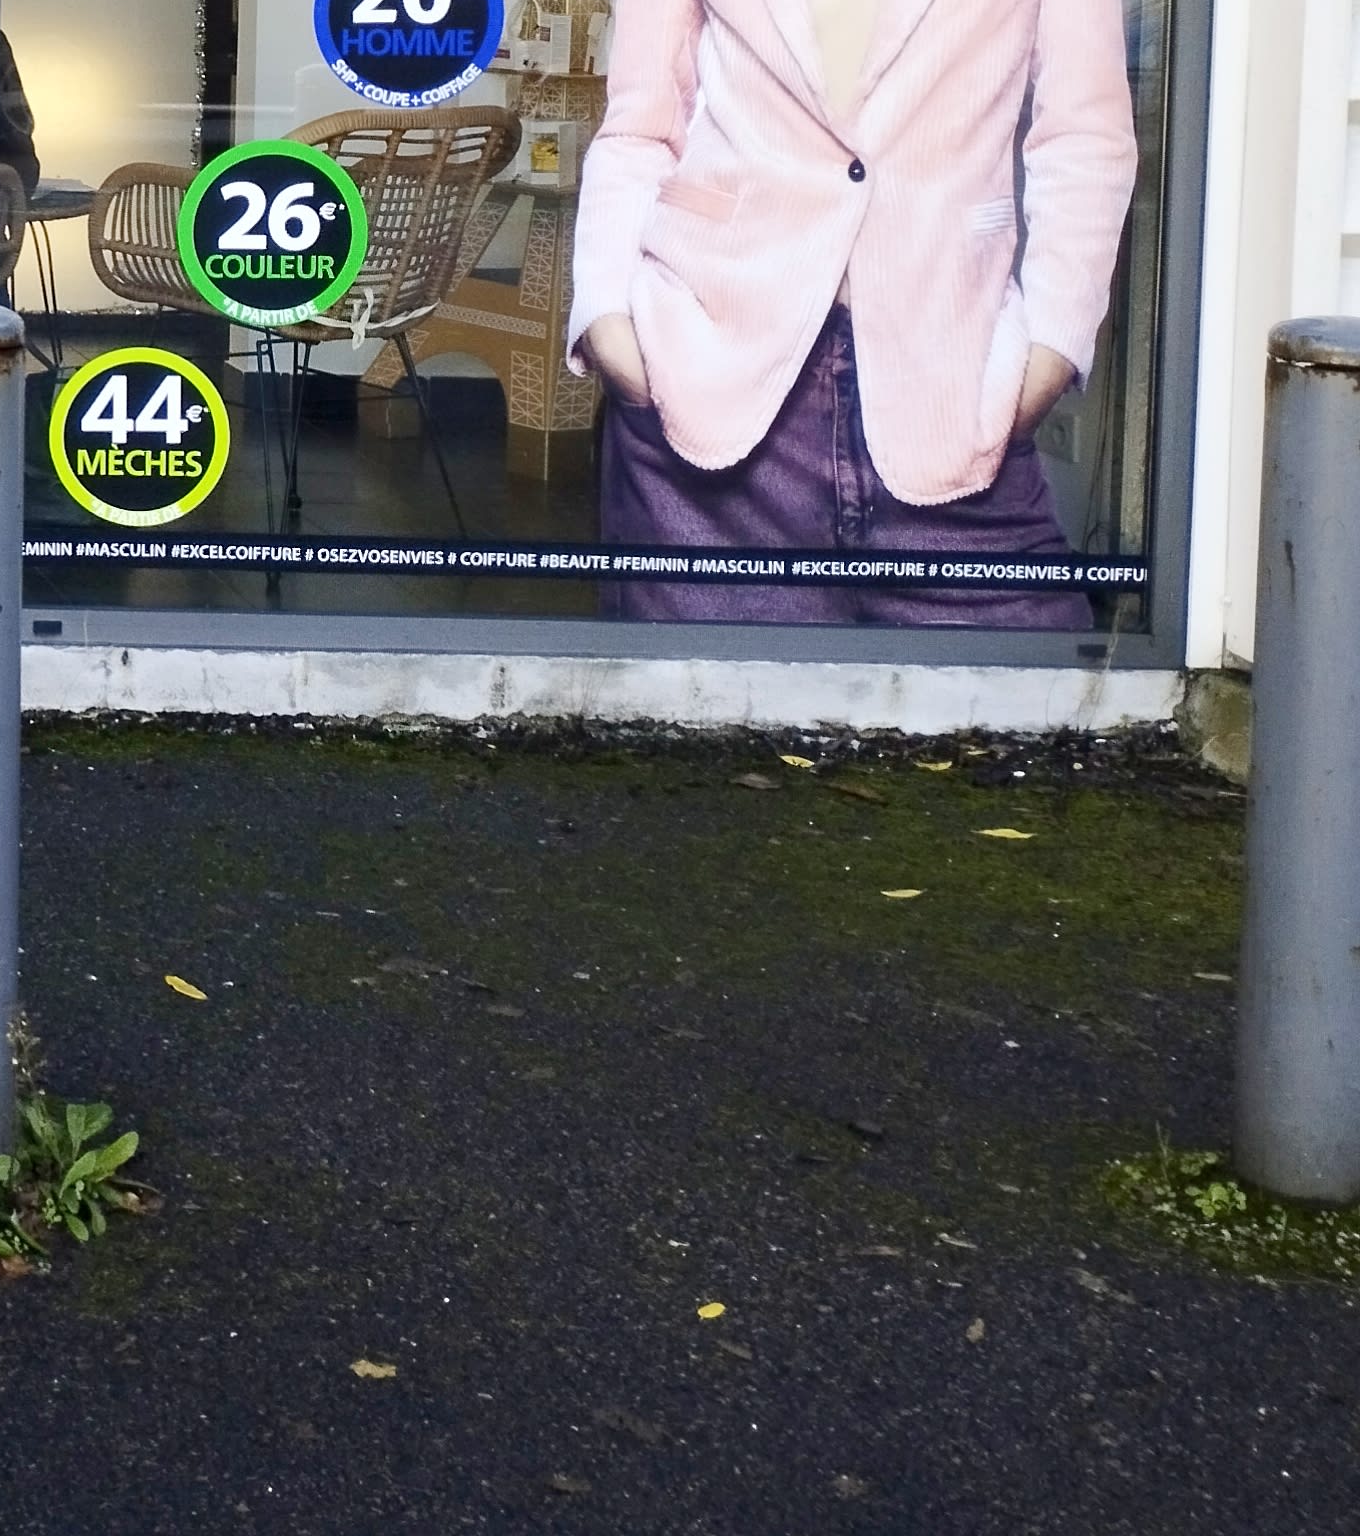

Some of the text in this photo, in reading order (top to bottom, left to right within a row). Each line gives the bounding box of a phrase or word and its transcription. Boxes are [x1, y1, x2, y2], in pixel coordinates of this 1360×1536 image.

[341, 28, 475, 57] HOMME
[331, 58, 358, 83] SHP
[363, 83, 411, 107] COUPE
[420, 62, 483, 106] COIFFAGE
[205, 254, 336, 280] COULEUR
[240, 304, 295, 324] PARTIR
[295, 299, 319, 319] DE
[76, 444, 204, 478] MÈCHES
[75, 542, 167, 558] #MASCULIN
[171, 544, 302, 562] #EXCELCOIFFURE
[317, 548, 444, 565] OSEZVOSENVIES
[459, 551, 537, 568] COIFFURE
[539, 553, 610, 570] #BEAUTE
[613, 556, 689, 572] #FEMININ
[692, 559, 785, 575] #MASCULIN
[791, 561, 925, 577] #EXCELCOIFFURE
[941, 563, 1071, 580] OSEZVOSENVIES
